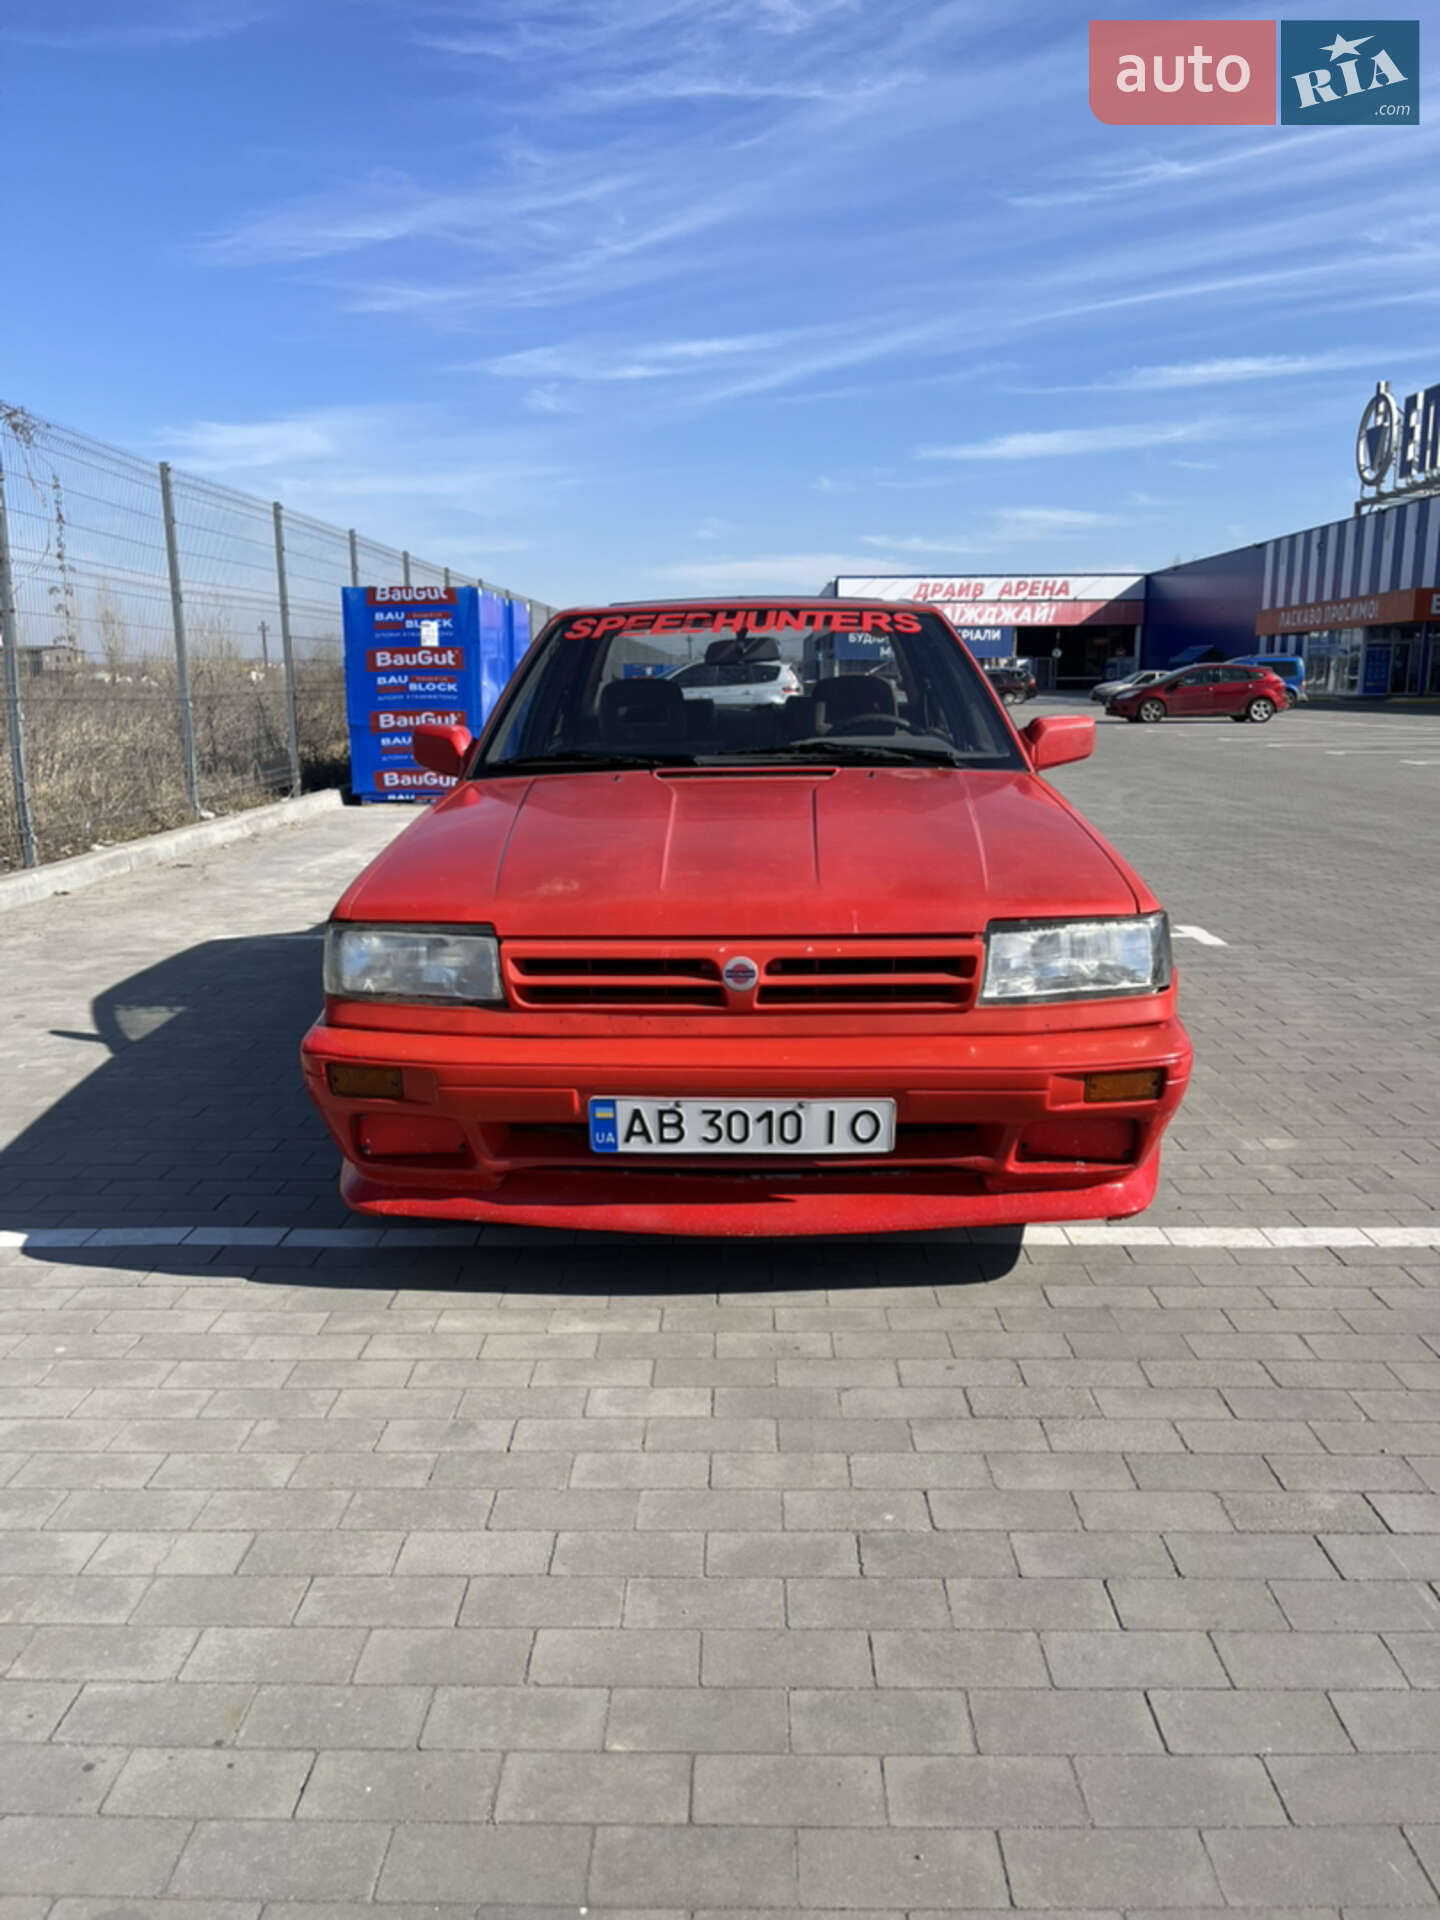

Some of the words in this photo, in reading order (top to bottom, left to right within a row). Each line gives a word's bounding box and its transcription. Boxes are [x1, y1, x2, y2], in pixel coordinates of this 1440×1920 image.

[376, 586, 448, 601] BauGut
[913, 581, 985, 600] ДРАЙВ
[995, 580, 1071, 597] АРЕНА
[374, 611, 405, 621] BAU
[942, 603, 1057, 625] АЇЖДЖАЙ!
[1279, 607, 1321, 627] ЛАСКАВО
[957, 628, 1001, 641] РІАЛИ
[375, 650, 456, 667] BauGut
[376, 675, 408, 685] BAU
[408, 683, 458, 692] BLOCK
[379, 711, 458, 729] BauGut
[381, 736, 412, 746] BAU
[623, 1108, 686, 1144] AB
[701, 1108, 803, 1144] 3010
[596, 1132, 615, 1144] UA
